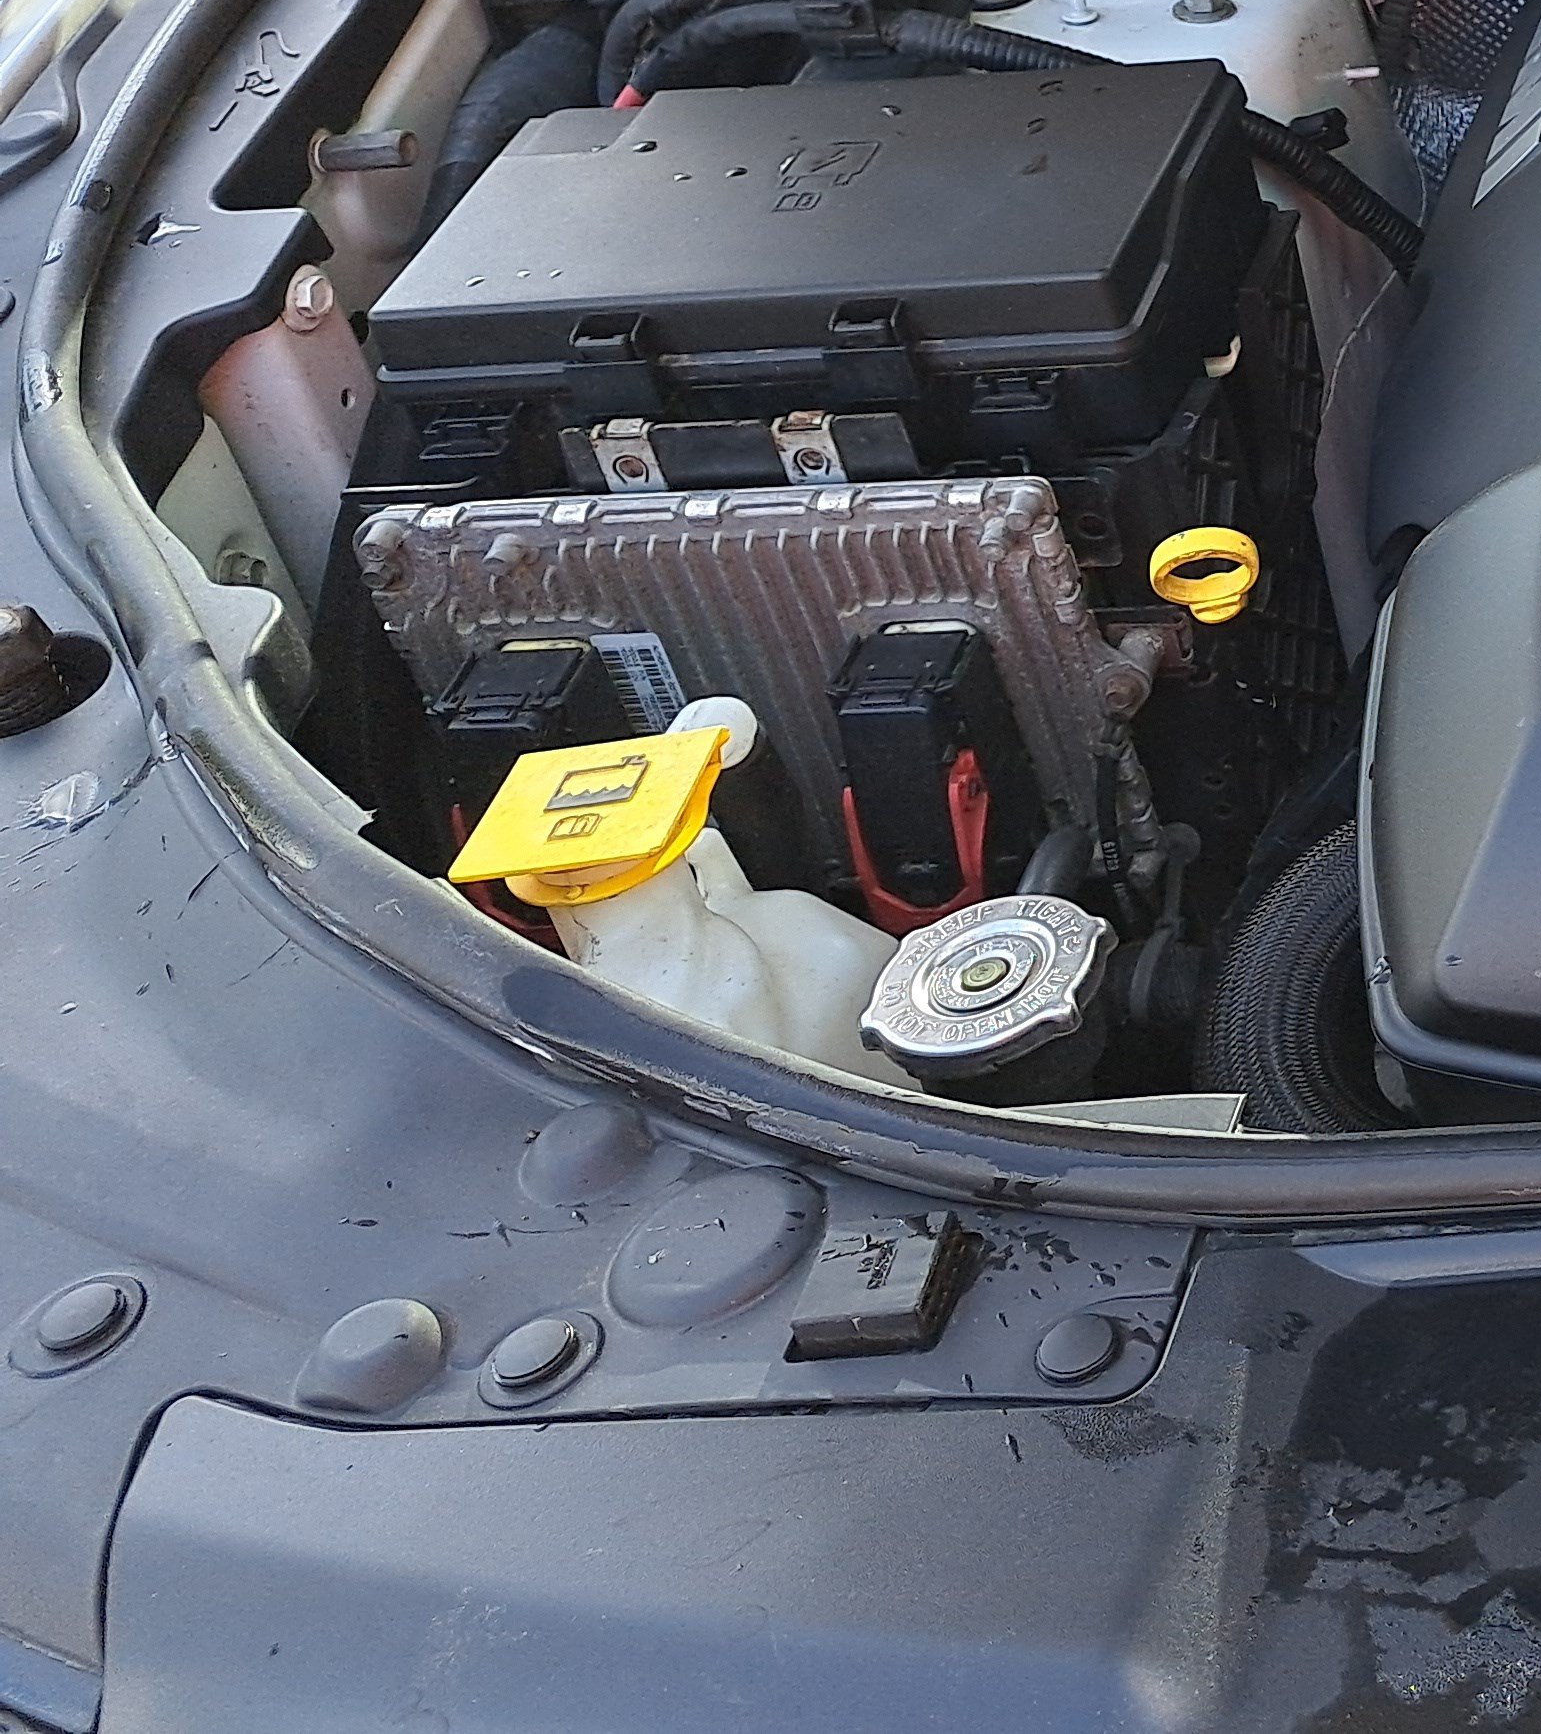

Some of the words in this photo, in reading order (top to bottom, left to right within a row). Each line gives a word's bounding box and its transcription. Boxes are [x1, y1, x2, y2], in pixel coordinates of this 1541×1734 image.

[1017, 899, 1082, 935] TIGHT
[887, 1006, 939, 1039] NOT
[941, 1010, 1016, 1043] OPEN
